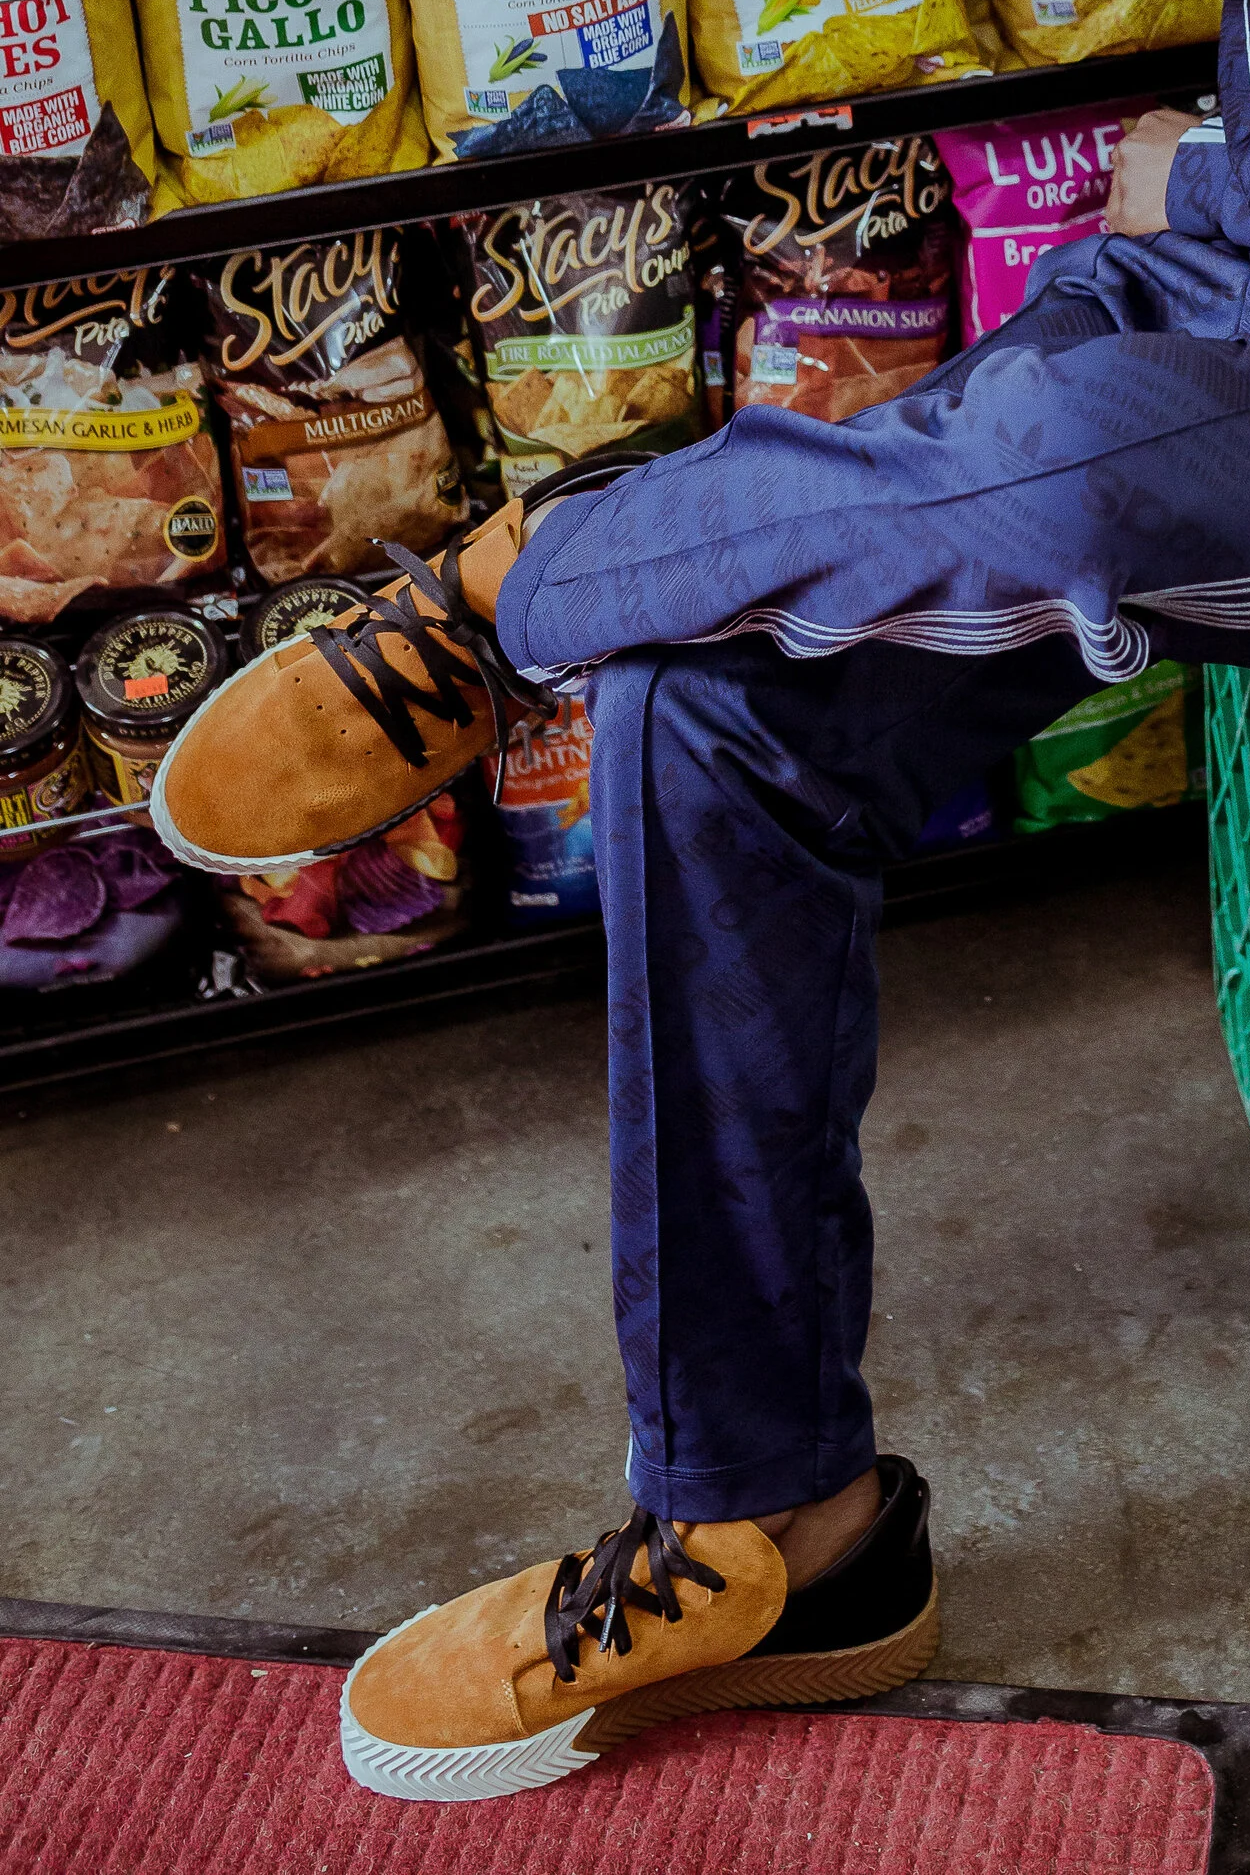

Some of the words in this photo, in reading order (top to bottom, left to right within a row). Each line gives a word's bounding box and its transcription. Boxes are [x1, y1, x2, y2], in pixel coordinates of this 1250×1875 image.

[543, 9, 570, 34] NO
[592, 26, 645, 54] ORGANIC
[223, 53, 258, 69] Corn
[261, 50, 314, 67] Tortilla
[316, 41, 357, 63] Chips
[2, 106, 43, 125] MADE
[43, 94, 81, 116] WITH
[9, 133, 45, 156] BLUE
[46, 119, 87, 145] CORN
[13, 110, 78, 139] ORGANIC
[984, 124, 1120, 187] LUKE
[470, 179, 677, 324] Stacy's
[791, 303, 897, 328] CINNAMON
[500, 346, 531, 363] FIRE
[73, 421, 138, 440] GARLIC
[143, 422, 155, 438] &
[159, 412, 194, 436] HERB
[305, 396, 426, 444] MULTIGRAIN
